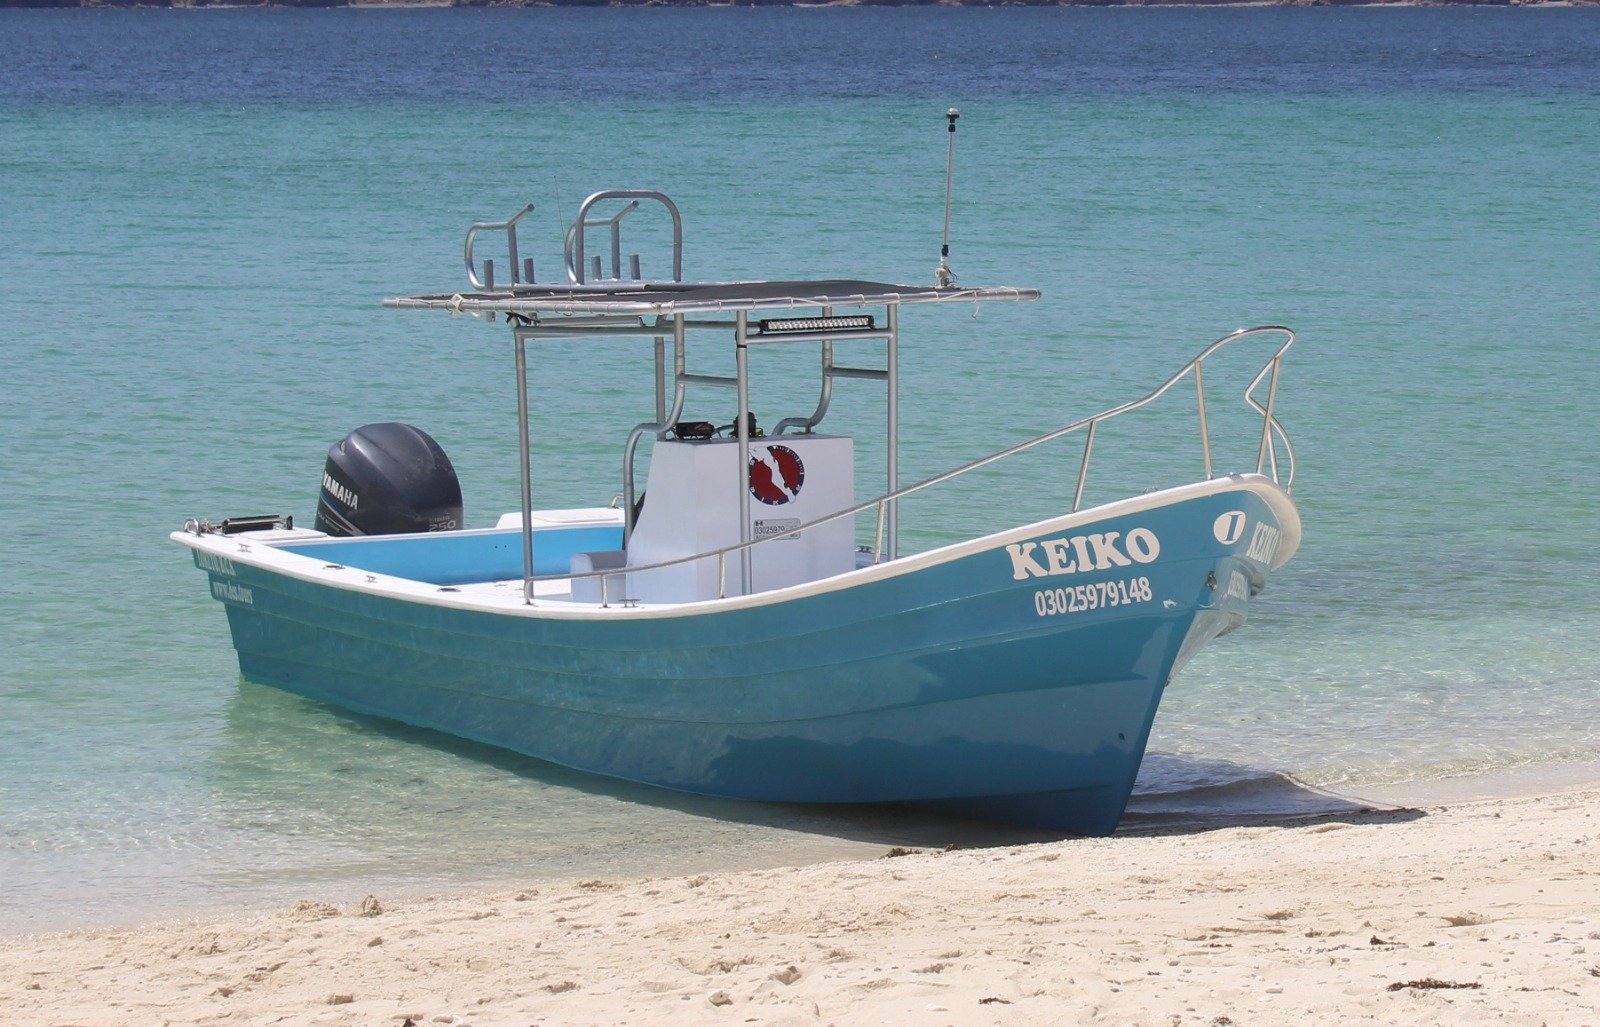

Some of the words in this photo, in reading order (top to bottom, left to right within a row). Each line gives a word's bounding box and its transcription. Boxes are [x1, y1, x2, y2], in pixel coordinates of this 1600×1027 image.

[322, 470, 359, 510] YAMAHA
[428, 519, 457, 533] 250
[1245, 520, 1281, 566] KEIKO
[1006, 527, 1161, 581] KEIKO
[1034, 576, 1153, 617] 03025979148
